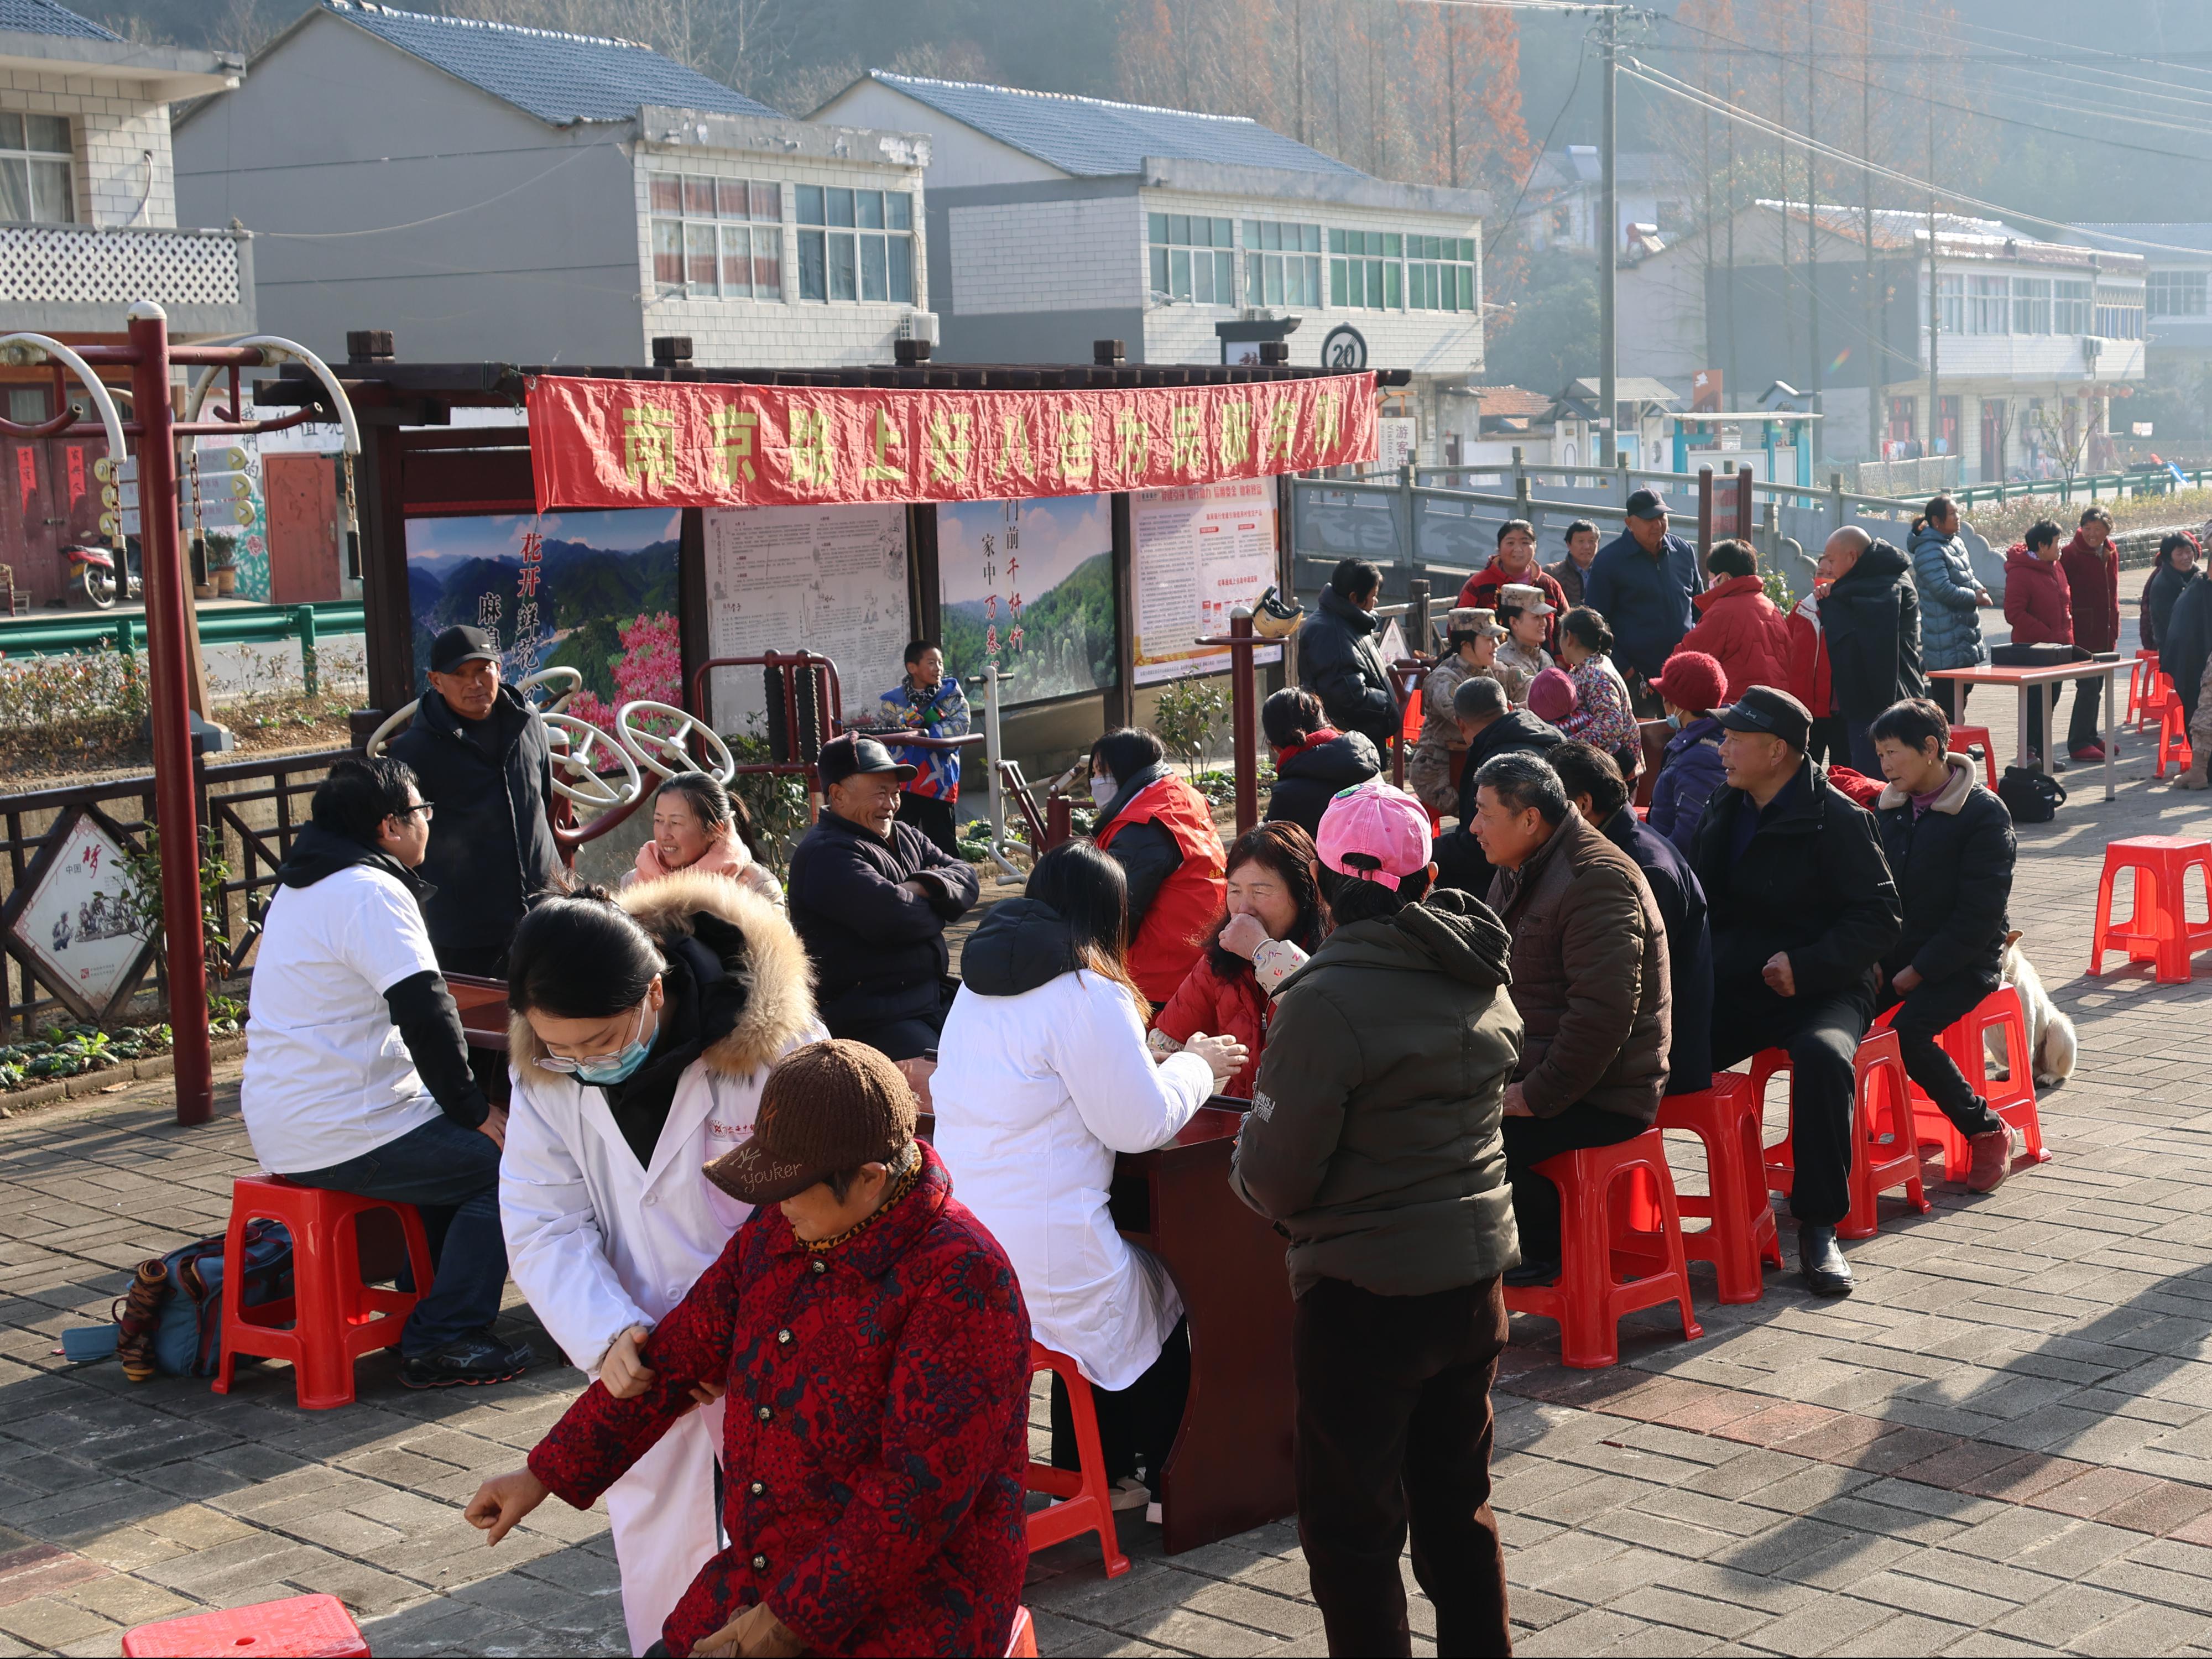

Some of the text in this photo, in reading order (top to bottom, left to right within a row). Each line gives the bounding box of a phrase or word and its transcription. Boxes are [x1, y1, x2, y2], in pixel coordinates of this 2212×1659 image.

[1333, 343, 1355, 367] 20
[1396, 425, 1410, 467] 游客中
[982, 533, 1001, 667] 家中万卷
[65, 863, 81, 875] 中国
